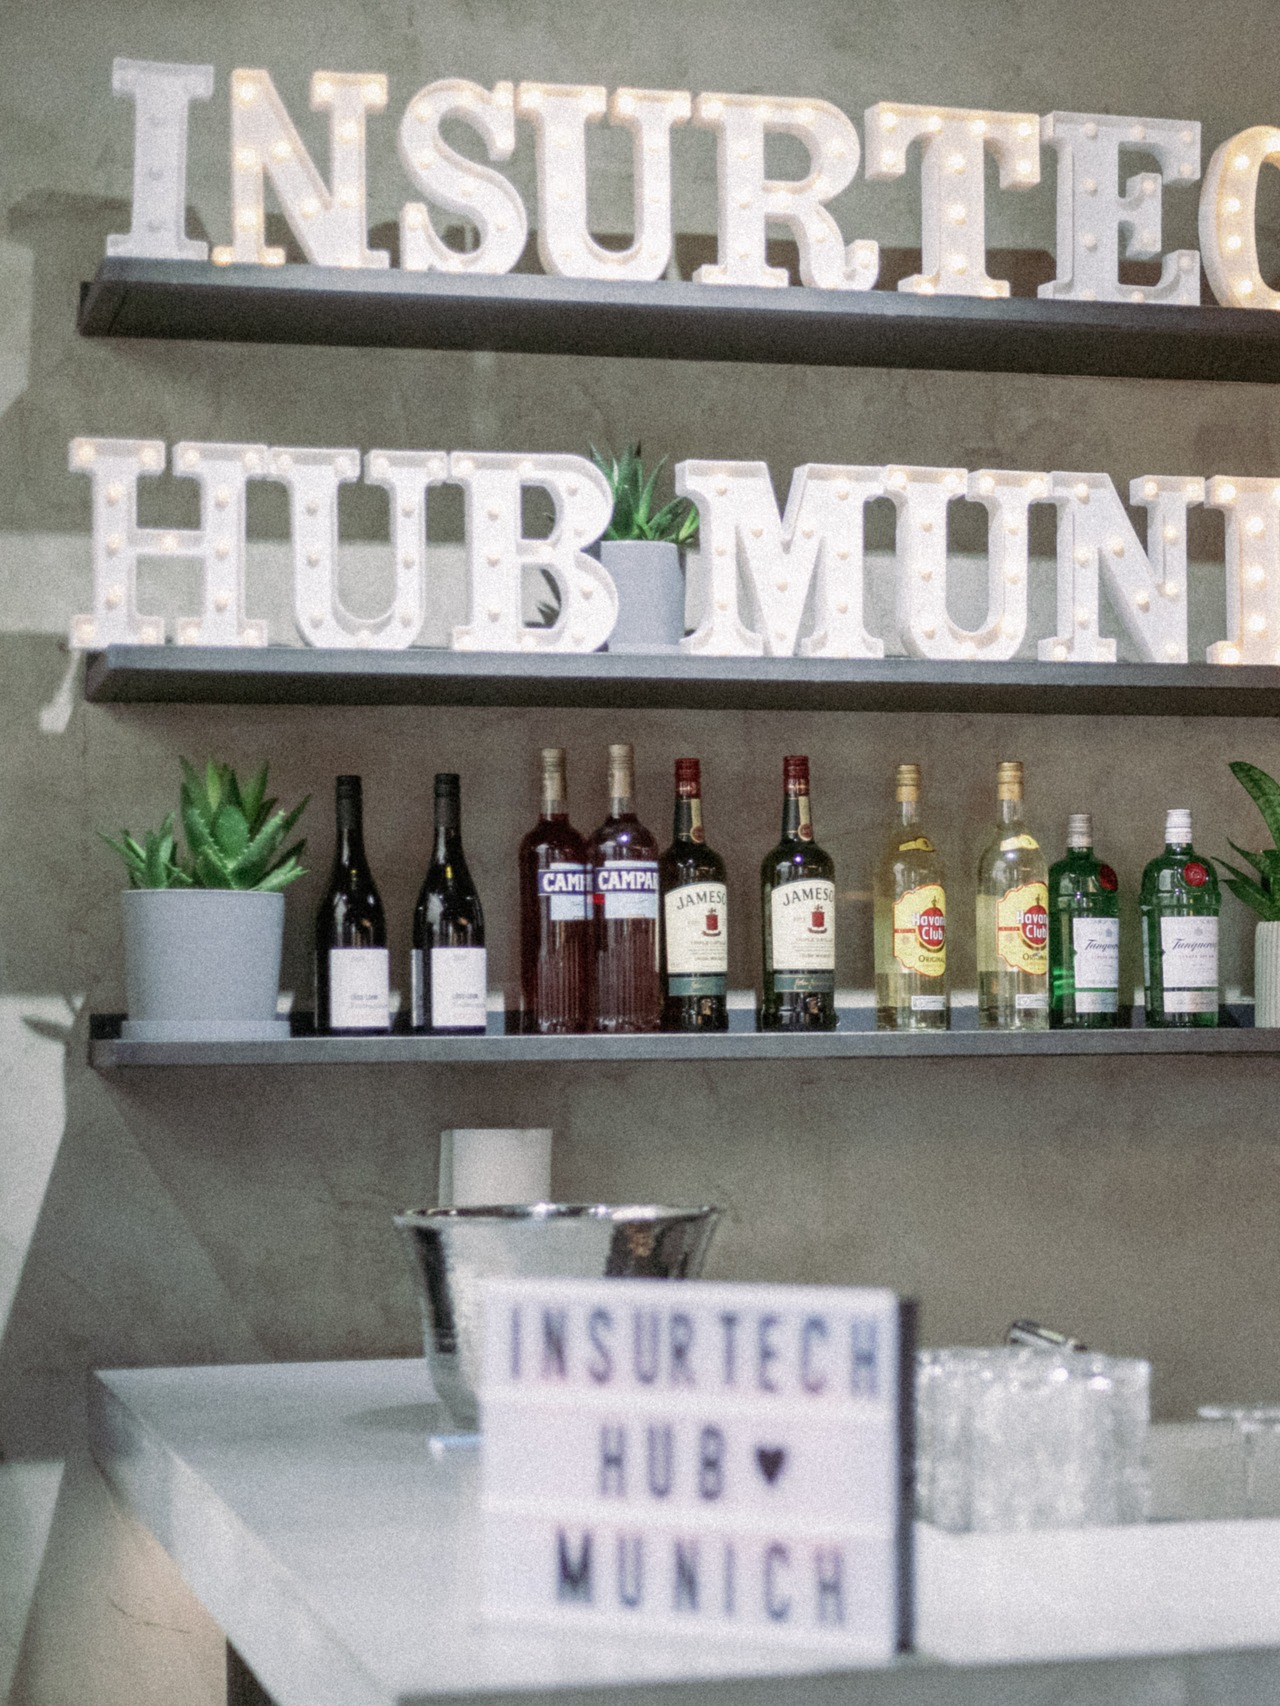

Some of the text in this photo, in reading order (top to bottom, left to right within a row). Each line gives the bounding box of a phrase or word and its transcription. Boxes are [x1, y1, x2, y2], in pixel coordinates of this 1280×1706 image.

[68, 437, 618, 653] HUB
[921, 926, 944, 940] Club
[509, 1305, 880, 1398] INSURTECH
[599, 1422, 726, 1500] HUB
[556, 1525, 847, 1628] MUNICH
